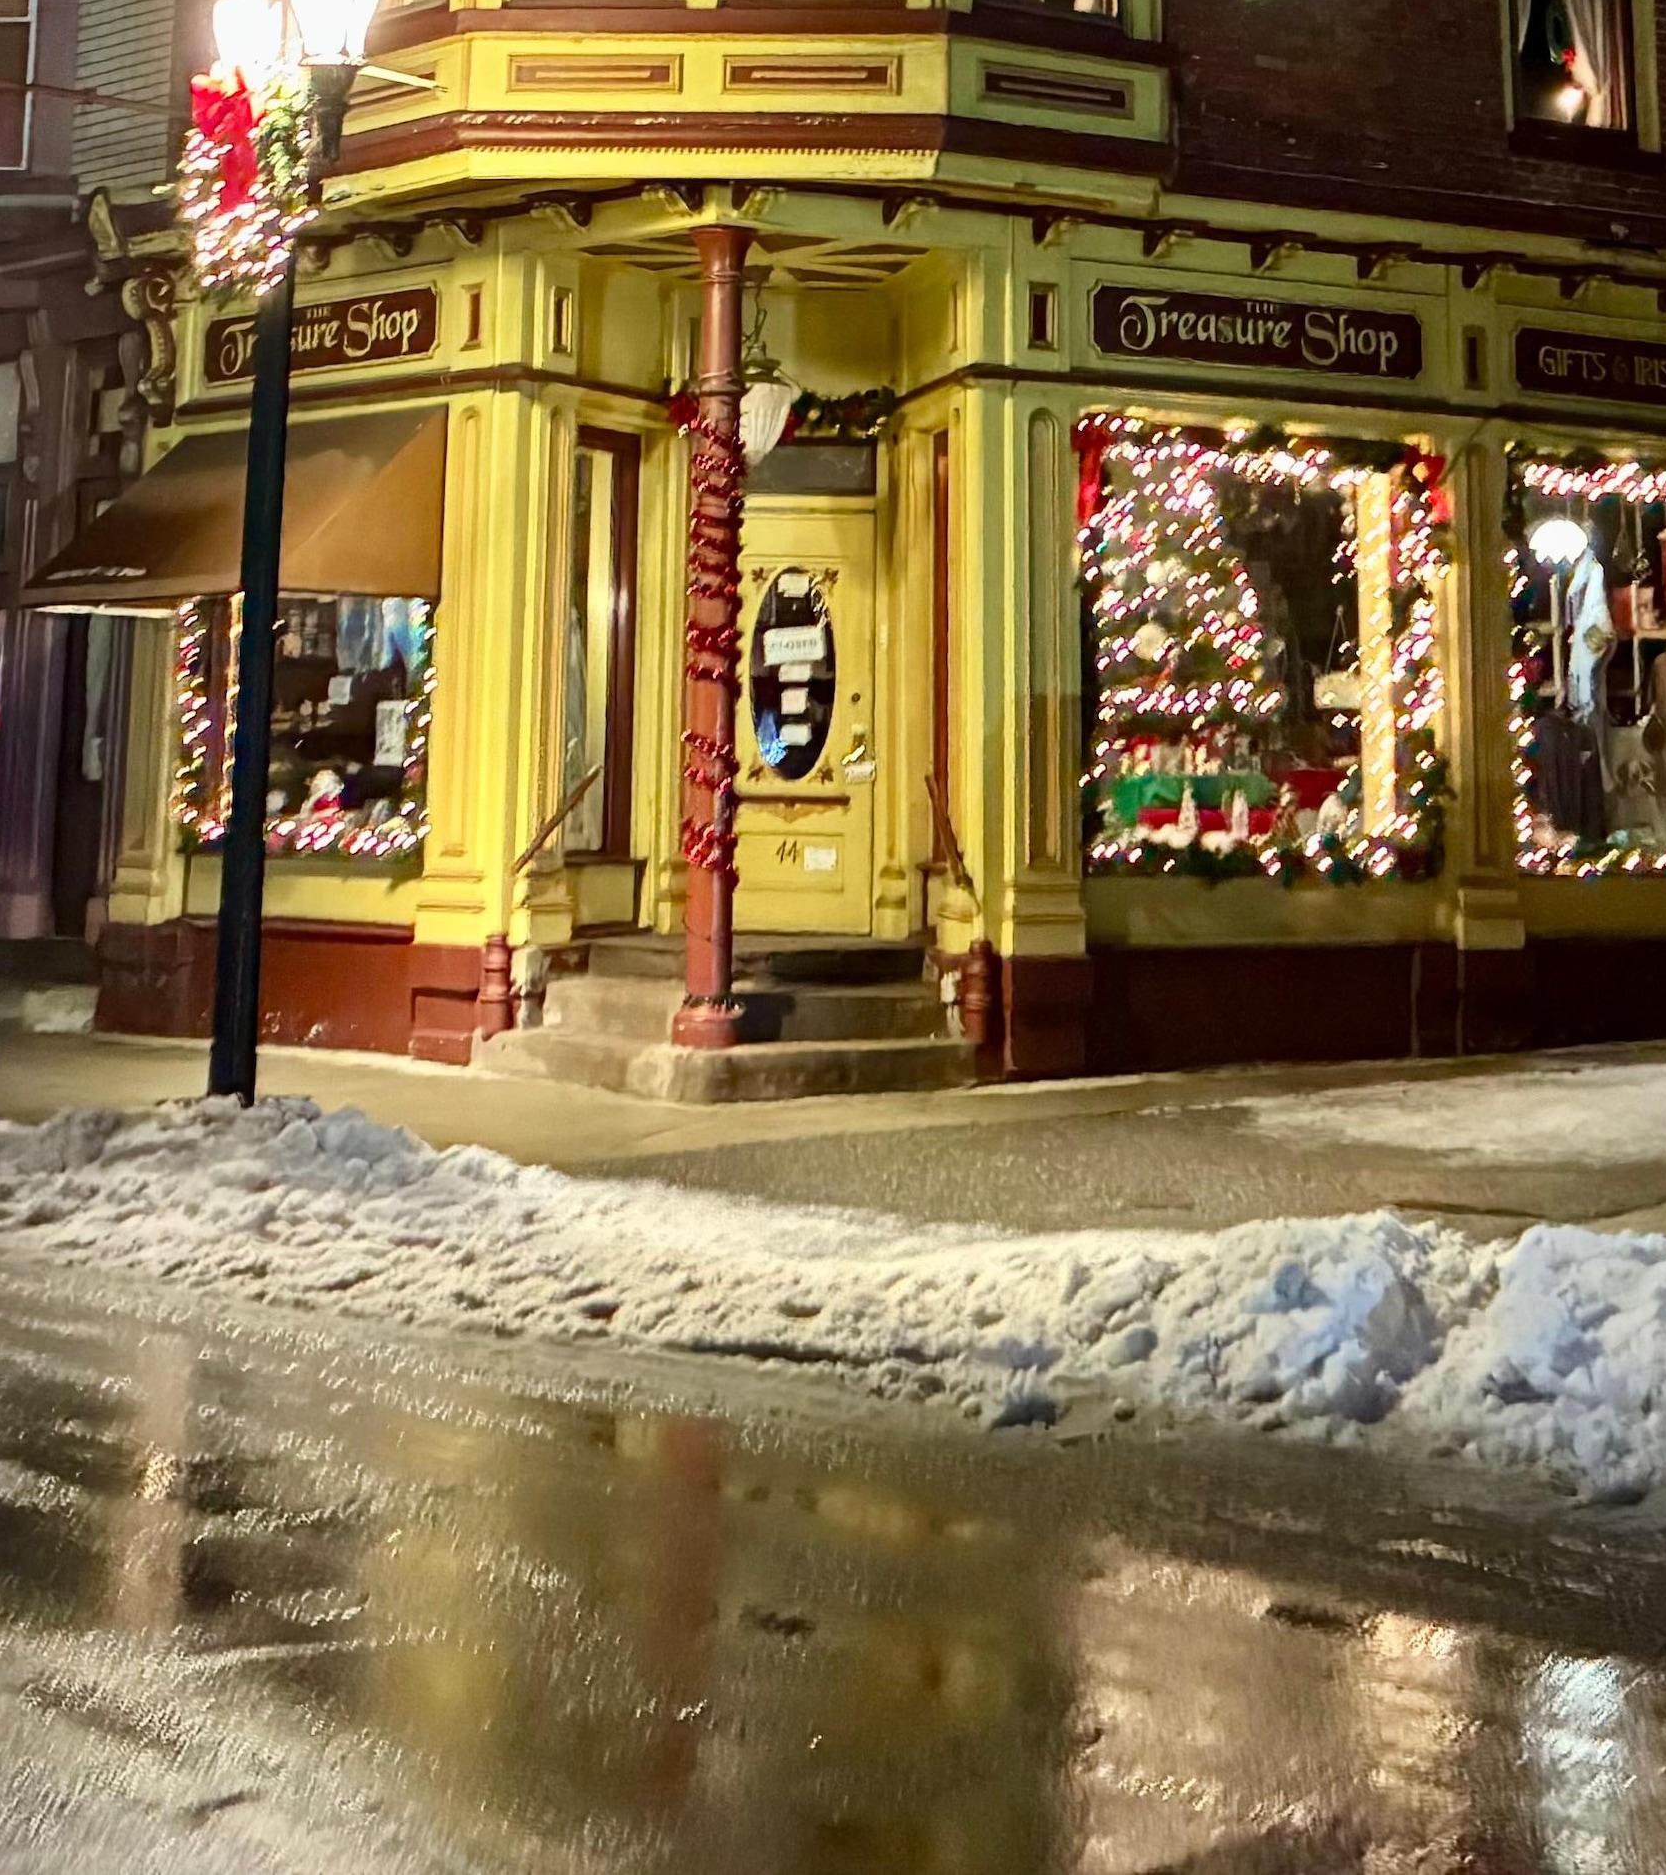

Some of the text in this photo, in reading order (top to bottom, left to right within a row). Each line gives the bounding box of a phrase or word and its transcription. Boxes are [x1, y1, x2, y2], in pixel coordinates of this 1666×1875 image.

[343, 301, 419, 357] Shop
[1120, 295, 1398, 372] Treasure Shop
[1538, 345, 1608, 381] GIFTS
